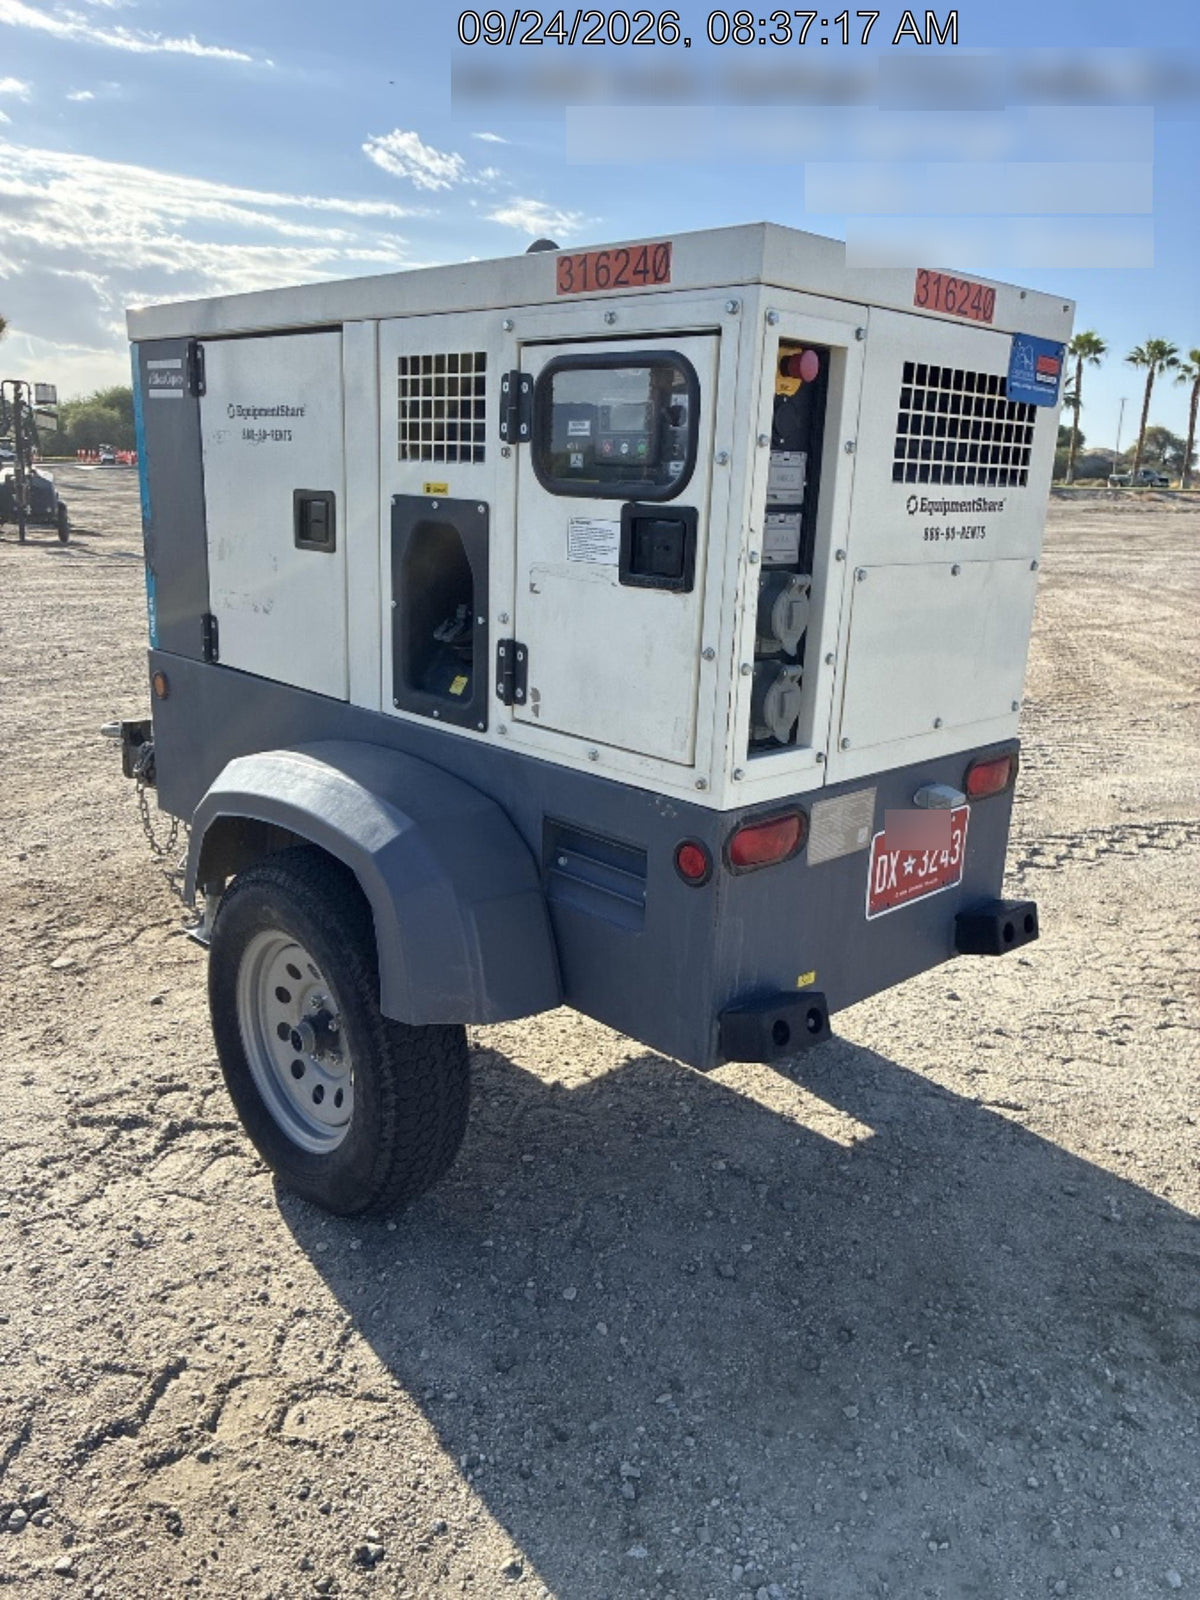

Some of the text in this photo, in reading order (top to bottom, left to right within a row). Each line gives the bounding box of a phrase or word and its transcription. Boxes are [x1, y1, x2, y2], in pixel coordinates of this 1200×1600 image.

[559, 243, 669, 292] 316240
[916, 270, 994, 322] 316240
[919, 497, 1005, 516] EquipmentShare
[874, 850, 900, 895] DX
